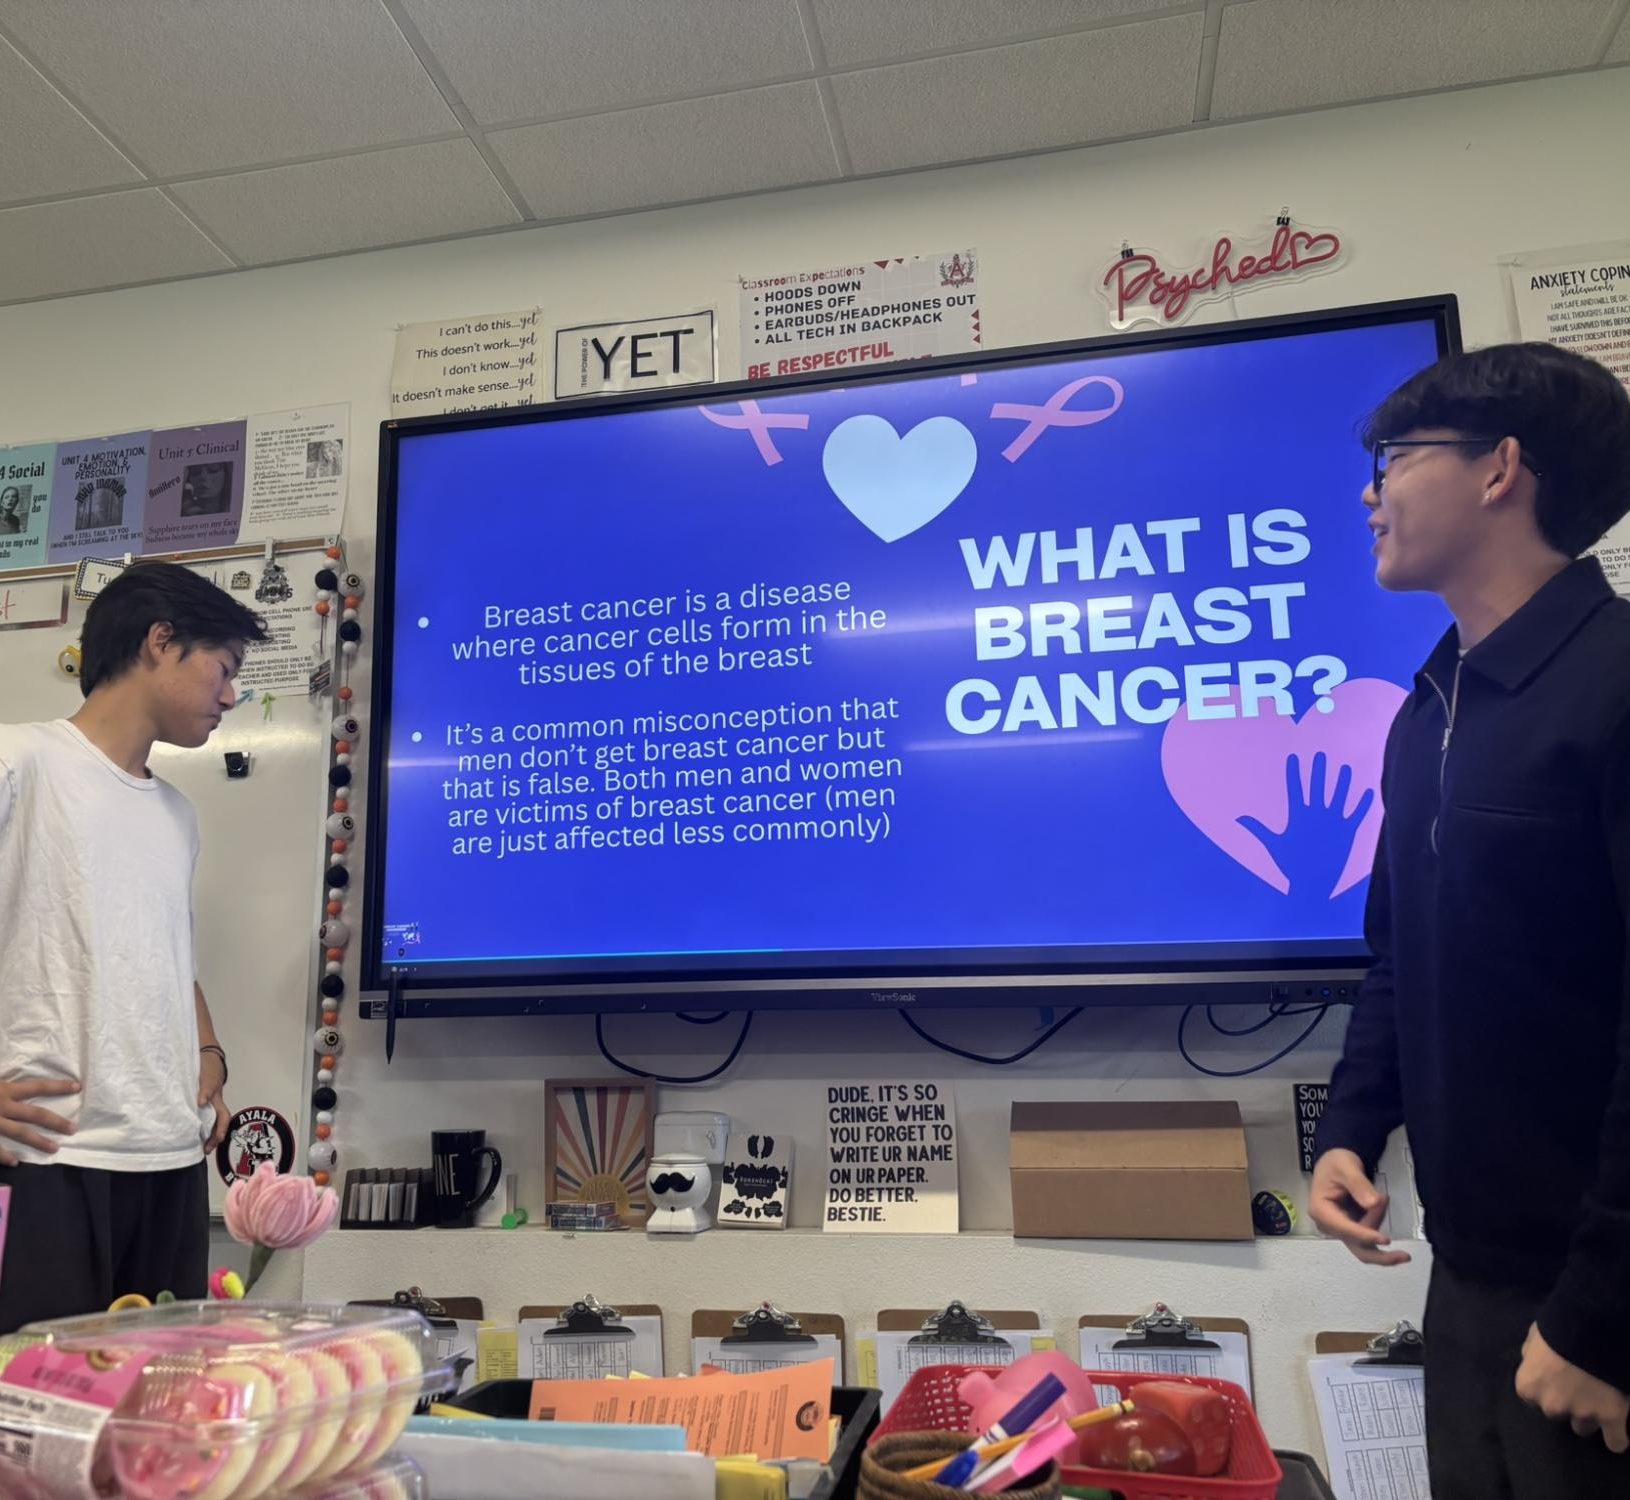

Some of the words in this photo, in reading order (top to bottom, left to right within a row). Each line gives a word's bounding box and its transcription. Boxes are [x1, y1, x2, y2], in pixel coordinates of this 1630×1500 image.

[1104, 225, 1293, 322] Psyched
[1531, 270, 1585, 290] ANXIETY
[1590, 265, 1630, 282] COPIN
[765, 286, 813, 302] HOODS
[818, 280, 861, 296] DOWN
[1561, 281, 1615, 297] statements
[765, 300, 823, 316] PHONES
[828, 295, 856, 308] OFF
[765, 298, 942, 331] EARBUDS/HEADPHONES
[946, 294, 977, 308] OUT
[446, 323, 471, 336] can't
[474, 322, 489, 333] do
[765, 329, 793, 345] ALL
[797, 325, 835, 341] TECH
[840, 322, 856, 335] IN
[862, 312, 943, 332] BACKPACK
[416, 348, 439, 360] This
[441, 342, 481, 357] doesn't
[591, 327, 695, 381] YET
[748, 363, 771, 380] BE
[777, 341, 894, 375] RESPECTFUL
[449, 363, 477, 376] don't
[392, 393, 399, 404] It
[402, 387, 442, 402] doesn't
[445, 384, 475, 397] make
[61, 455, 80, 466] UNIT
[159, 447, 183, 460] Unit
[196, 440, 240, 456] Clinical
[9, 461, 45, 480] Social
[75, 464, 131, 480] PERSONALITY
[958, 517, 1201, 590] WHAT
[1227, 508, 1311, 569] IS
[485, 602, 572, 628] Breast
[581, 597, 676, 620] cancer
[686, 589, 706, 612] is
[716, 592, 731, 610] a
[740, 582, 850, 608] disease
[974, 582, 1307, 661] BREAST
[453, 635, 535, 660] where
[544, 630, 639, 653] cancer
[648, 619, 712, 645] cells
[721, 616, 790, 640] form
[802, 610, 826, 634] in
[836, 606, 886, 632] the
[519, 661, 615, 684] tissues
[625, 652, 654, 677] of
[661, 650, 708, 675] the
[719, 644, 812, 671] breast
[945, 654, 1348, 735] CANCER?
[448, 723, 483, 745] It's
[491, 727, 504, 742] a
[513, 719, 623, 741] common
[634, 702, 831, 734] misconception
[841, 698, 899, 721] that
[459, 753, 511, 771] men
[521, 744, 587, 768] don't
[595, 743, 635, 770] get
[645, 737, 728, 761] breast
[736, 734, 829, 755] cancer
[838, 727, 885, 750] but
[443, 778, 494, 800] that
[503, 775, 520, 796] is
[528, 772, 594, 795] false.
[605, 766, 665, 791] Both
[676, 768, 731, 787] men
[741, 759, 790, 784] and
[800, 759, 901, 780] women
[449, 809, 487, 827] are
[496, 800, 587, 824] victims
[597, 796, 623, 819] of
[632, 794, 715, 817] breast
[724, 792, 816, 813] cancer
[826, 785, 894, 811] (men
[453, 837, 492, 854] are
[497, 830, 547, 858] just
[555, 822, 664, 849] affected
[675, 822, 724, 844] less
[733, 812, 889, 843] commonly)
[879, 1085, 908, 1101] IT'S
[914, 1084, 938, 1101] SO
[239, 1110, 276, 1125] AYALA
[829, 1105, 889, 1124] CRINGE
[895, 1104, 945, 1122] WHEN
[830, 1127, 860, 1143] YOU
[866, 1124, 926, 1142] FORGET
[932, 1124, 953, 1141] TO
[1301, 1120, 1316, 1134] YO
[830, 1145, 879, 1163] WRITE
[882, 1145, 902, 1162] UR
[907, 1144, 953, 1162] NAME
[830, 1168, 851, 1184] ON
[856, 1167, 875, 1184] UR
[878, 1167, 928, 1183] PAPER.
[829, 1187, 852, 1203] DO
[827, 1206, 886, 1222] BESTIE.
